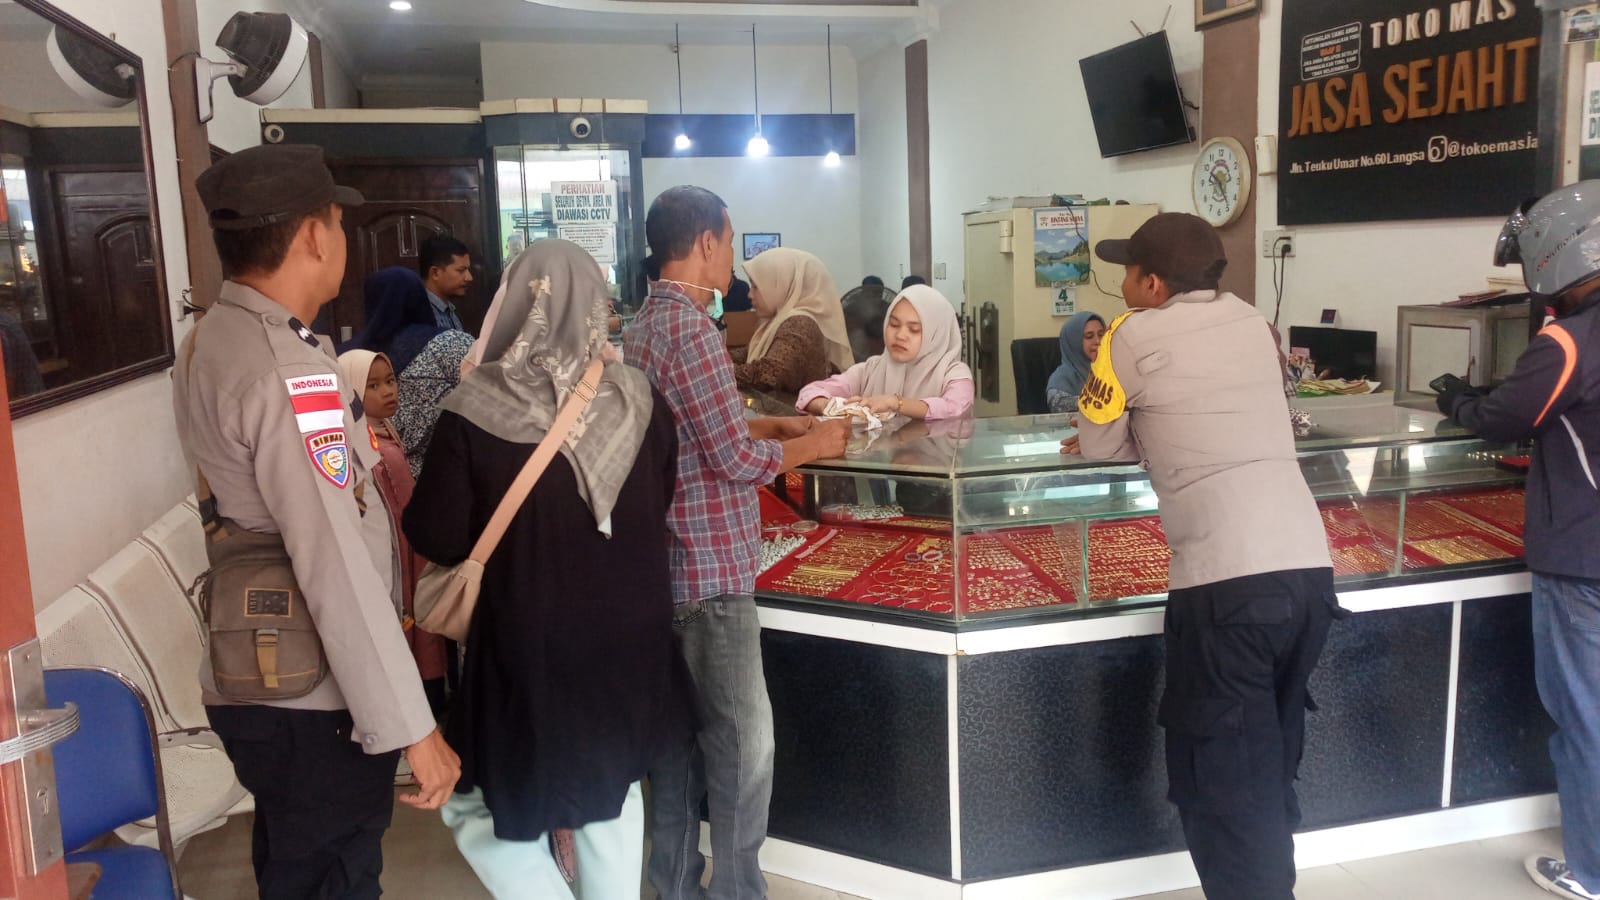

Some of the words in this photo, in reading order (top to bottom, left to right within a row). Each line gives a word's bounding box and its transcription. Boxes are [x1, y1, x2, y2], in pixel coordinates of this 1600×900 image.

[1370, 8, 1440, 48] TOKO
[1449, 0, 1516, 32] MAS
[1288, 72, 1372, 137] JASA
[1305, 158, 1333, 172] Teuku
[1334, 157, 1360, 169] Umar
[1387, 151, 1425, 165] Langsa
[561, 184, 605, 194] PERHATIAN
[557, 209, 589, 220] DIAWASI
[590, 208, 610, 220] CCTV
[1058, 288, 1068, 302] 4
[291, 379, 334, 390] INDONESIA
[312, 433, 343, 449] BINMAS
